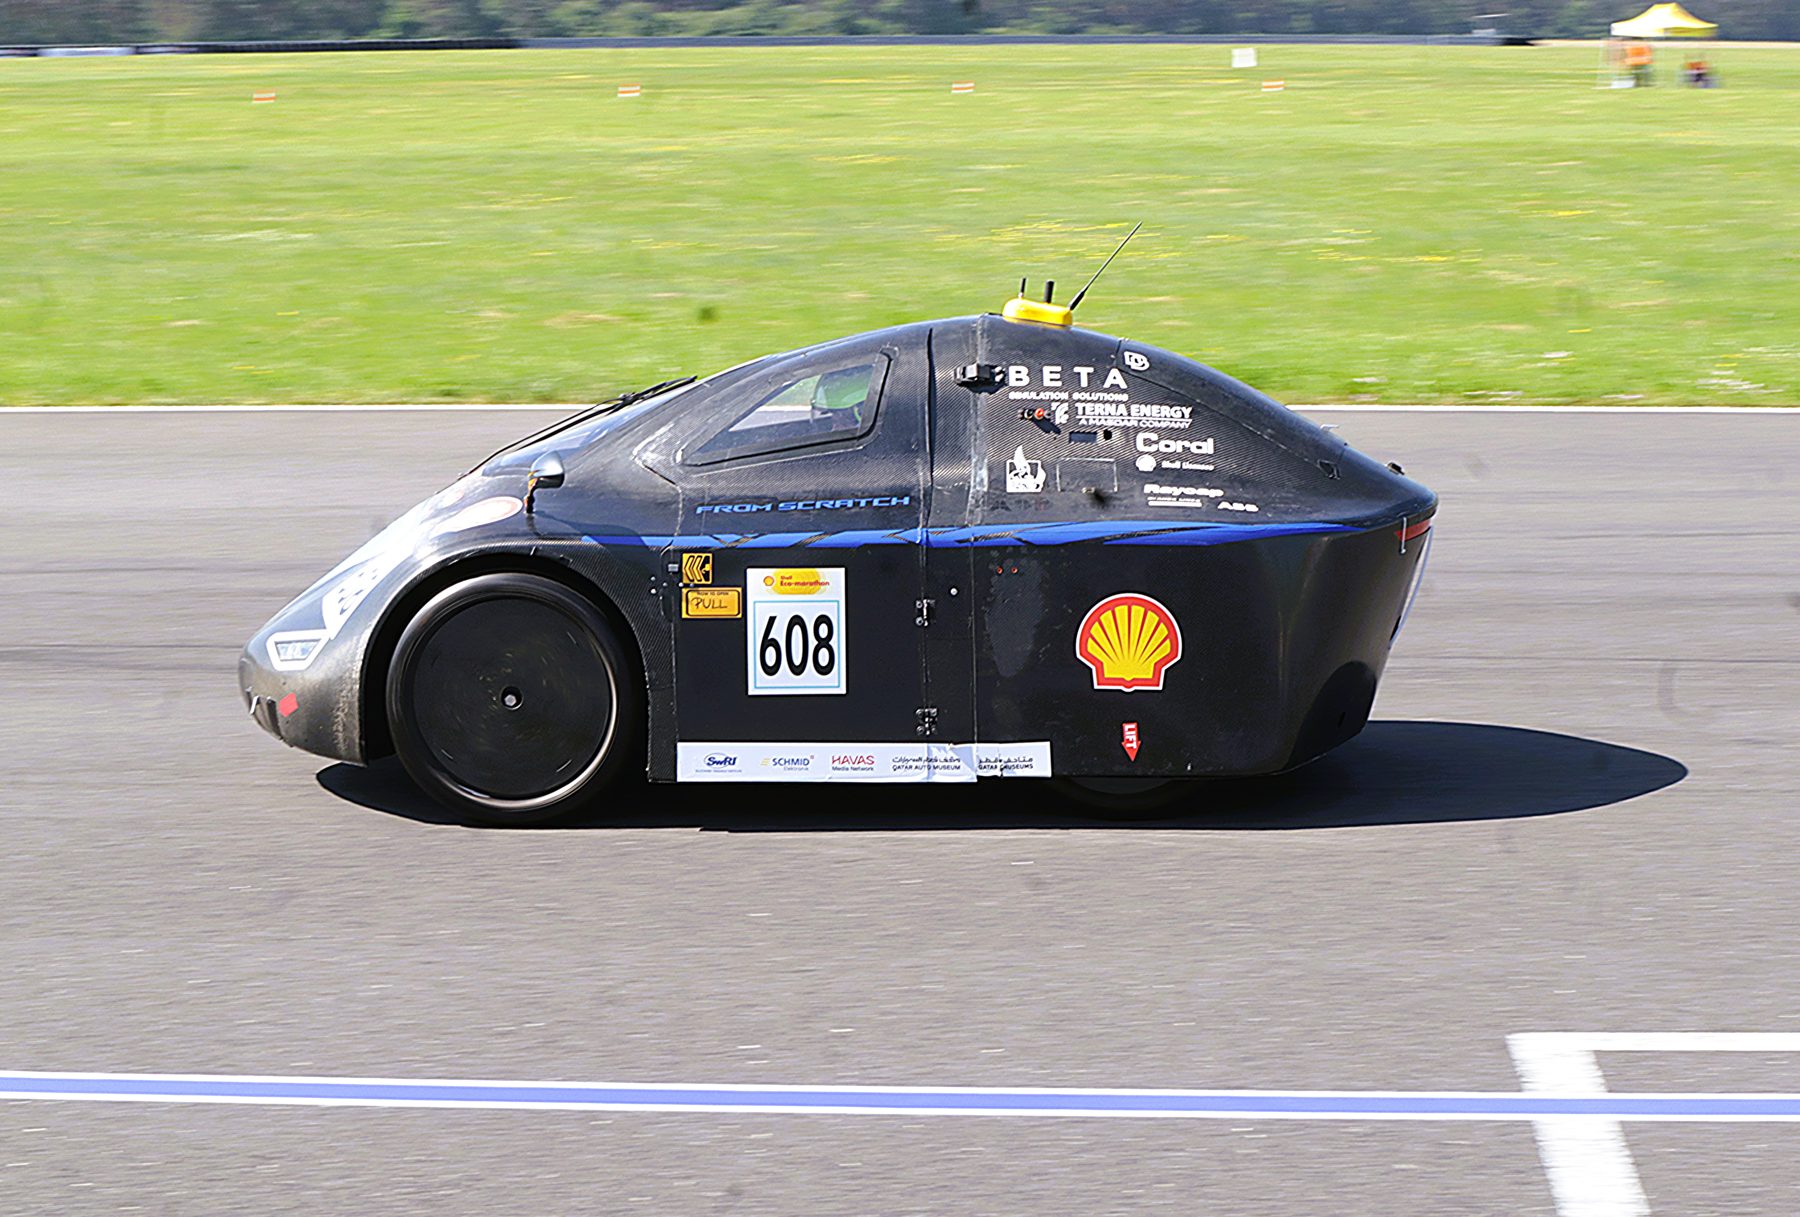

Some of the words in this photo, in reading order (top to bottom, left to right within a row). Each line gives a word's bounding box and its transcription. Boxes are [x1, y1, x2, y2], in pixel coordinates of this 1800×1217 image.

[1008, 365, 1128, 389] BETA
[1072, 392, 1129, 401] SOLUTIONS
[1075, 402, 1128, 416] TERNA
[1130, 404, 1192, 418] ENERGY
[1139, 420, 1191, 428] COMPANY
[1136, 432, 1214, 455] Coral
[696, 503, 772, 514] FROM
[778, 496, 910, 511] SCRATCH
[691, 596, 728, 609] PULL
[759, 614, 836, 677] 608
[1125, 724, 1137, 749] LIFT
[772, 757, 810, 766] SCHMID
[831, 755, 875, 765] HAVAS
[892, 764, 913, 772] QATAR
